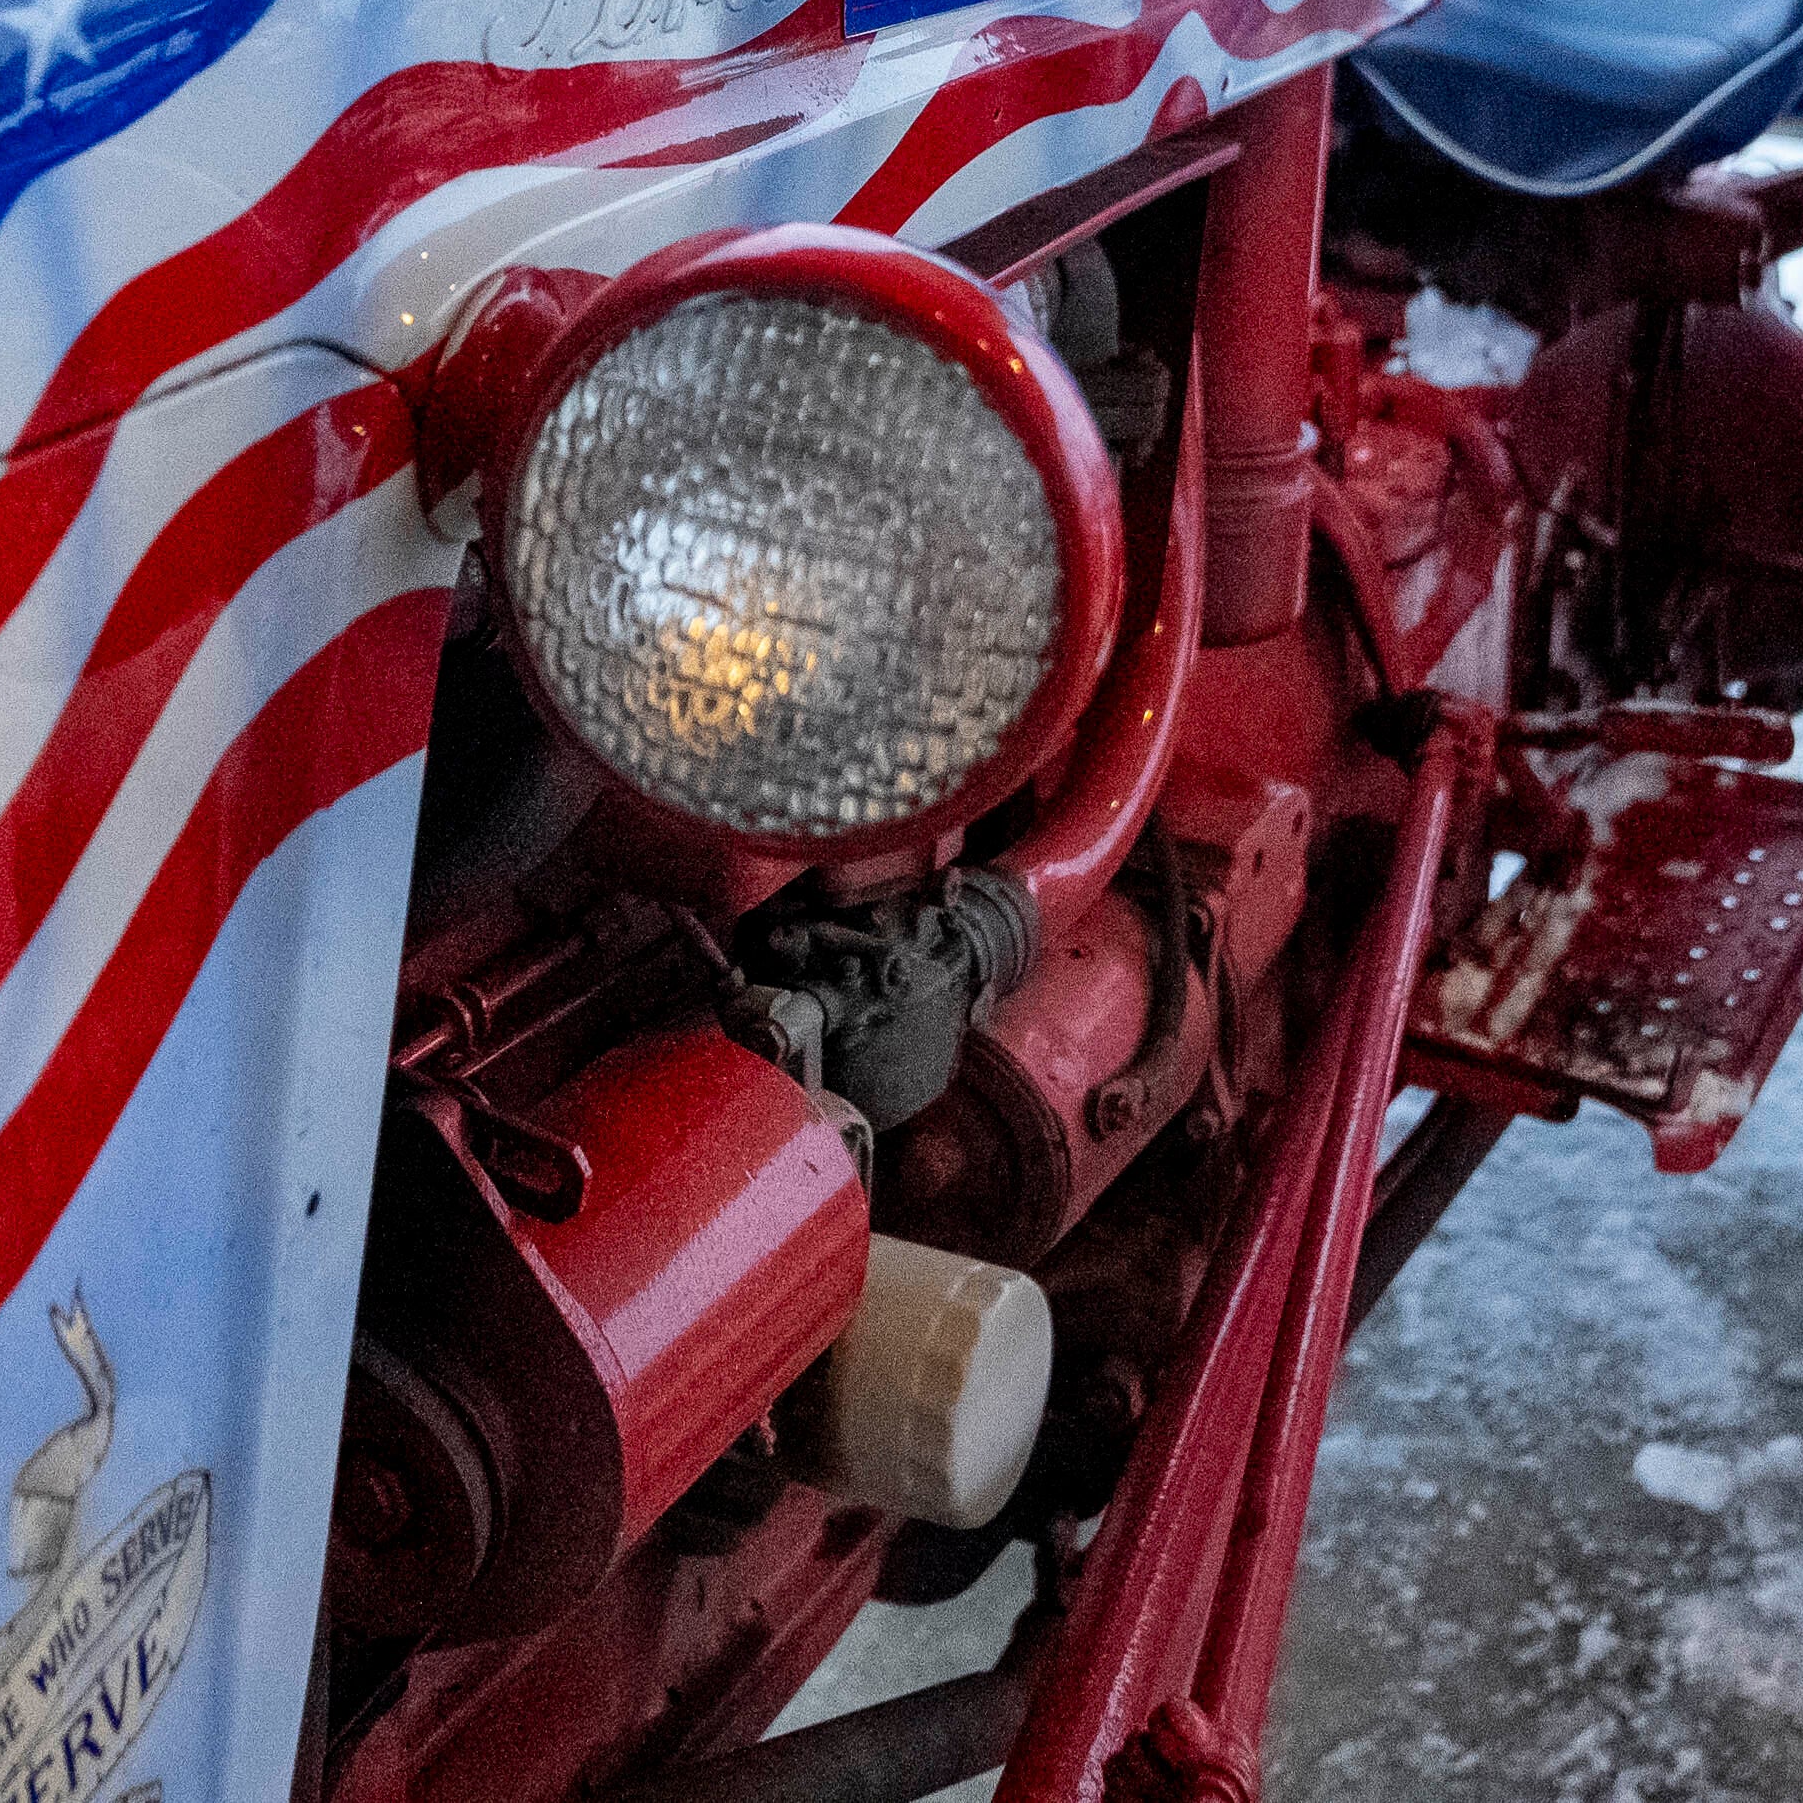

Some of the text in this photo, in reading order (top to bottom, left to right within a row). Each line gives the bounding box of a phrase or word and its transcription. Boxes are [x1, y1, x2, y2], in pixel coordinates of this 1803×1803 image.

[29, 1599, 91, 1695] WHO
[100, 1490, 196, 1609] SERVE
[1, 1603, 170, 1803] ERVE
